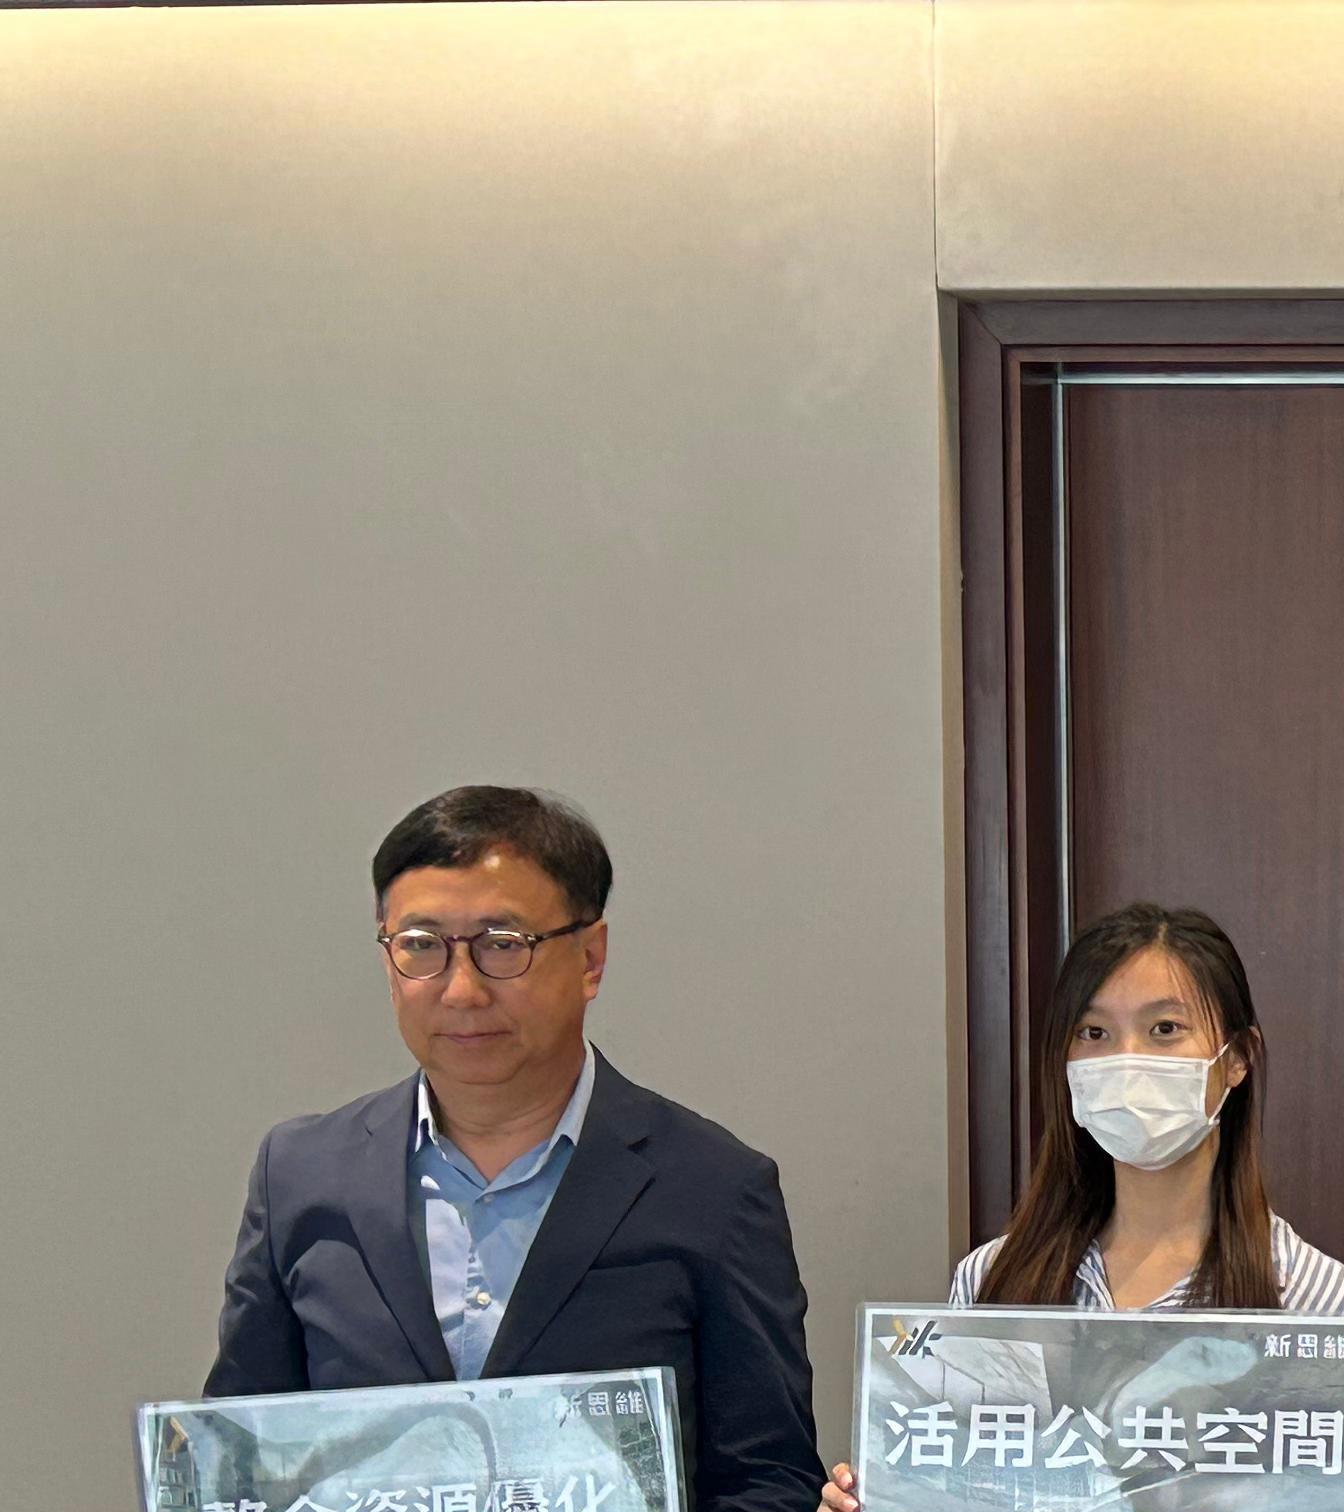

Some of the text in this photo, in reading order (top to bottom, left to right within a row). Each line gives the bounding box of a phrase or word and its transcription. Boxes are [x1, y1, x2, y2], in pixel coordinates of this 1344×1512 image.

[884, 1401, 1344, 1476] 活用公共空間
